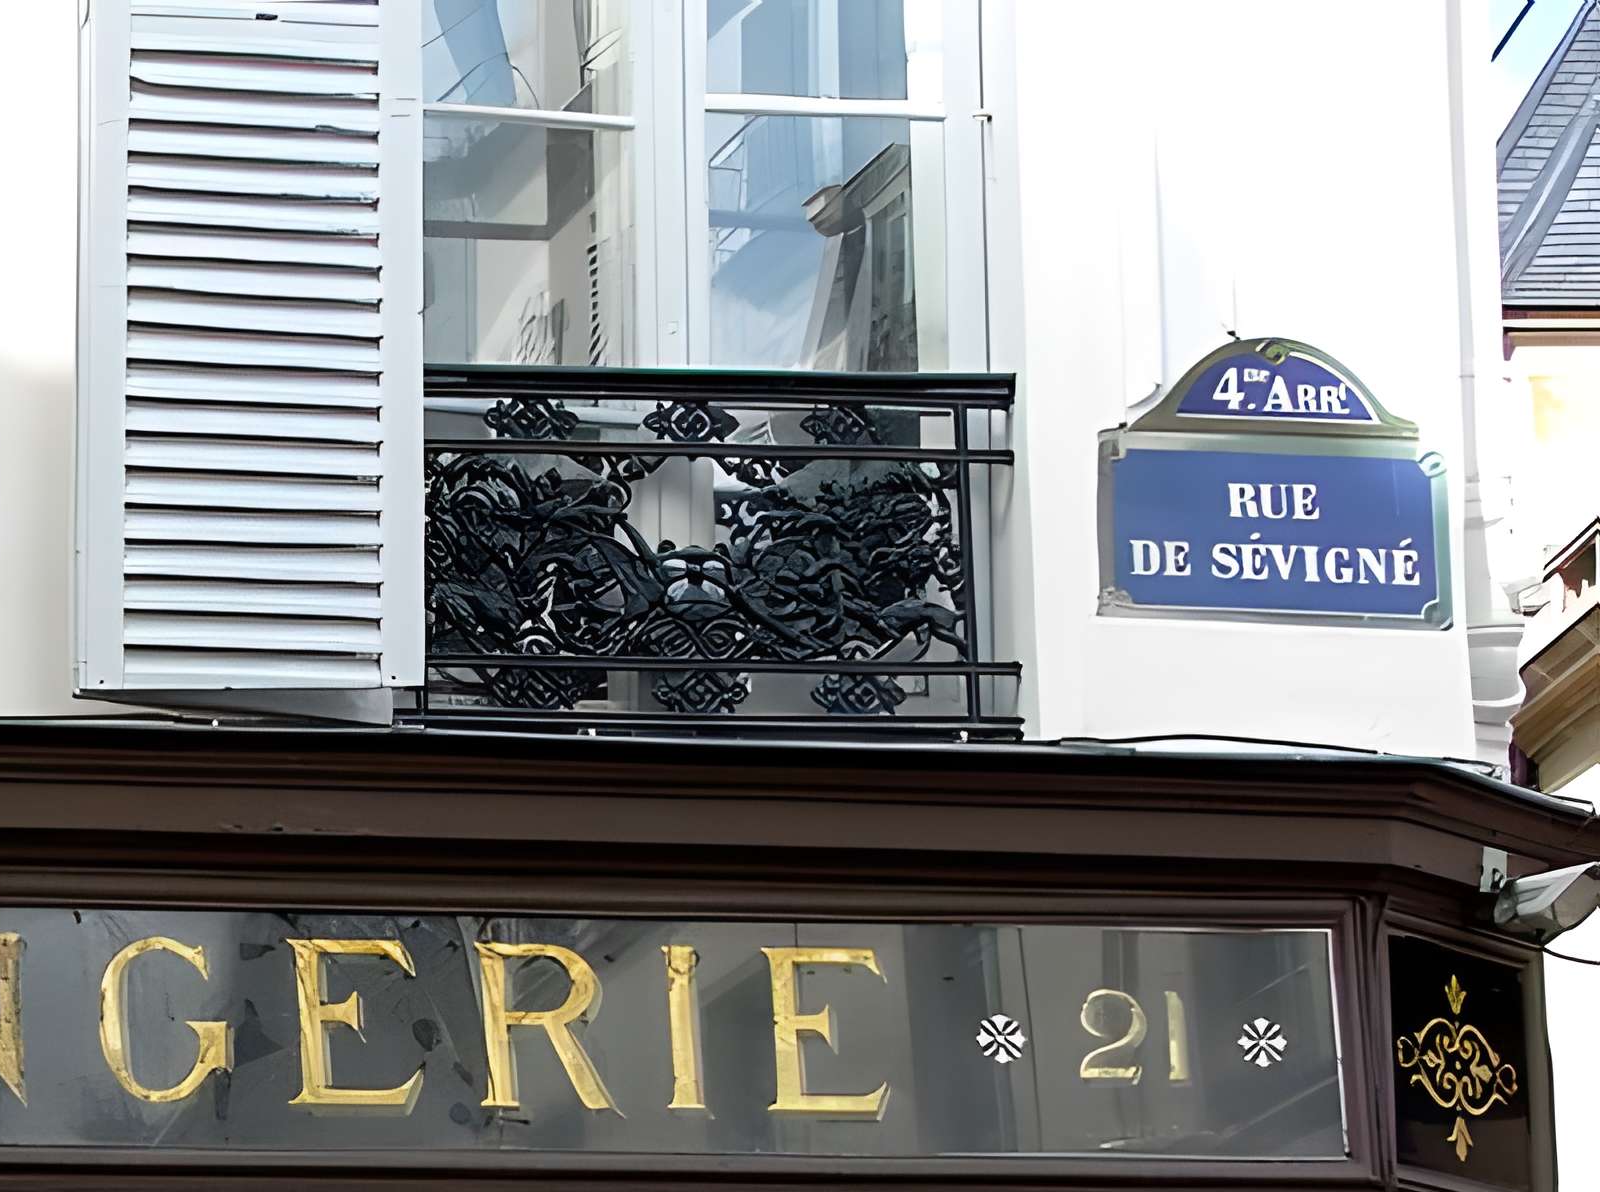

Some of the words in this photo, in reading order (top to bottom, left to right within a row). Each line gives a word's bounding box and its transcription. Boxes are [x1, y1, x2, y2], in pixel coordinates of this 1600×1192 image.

[1228, 482, 1320, 519] RUE
[1129, 539, 1191, 577] DE
[1211, 532, 1421, 585] SÉVIGNÉ
[1080, 988, 1190, 1086] 21
